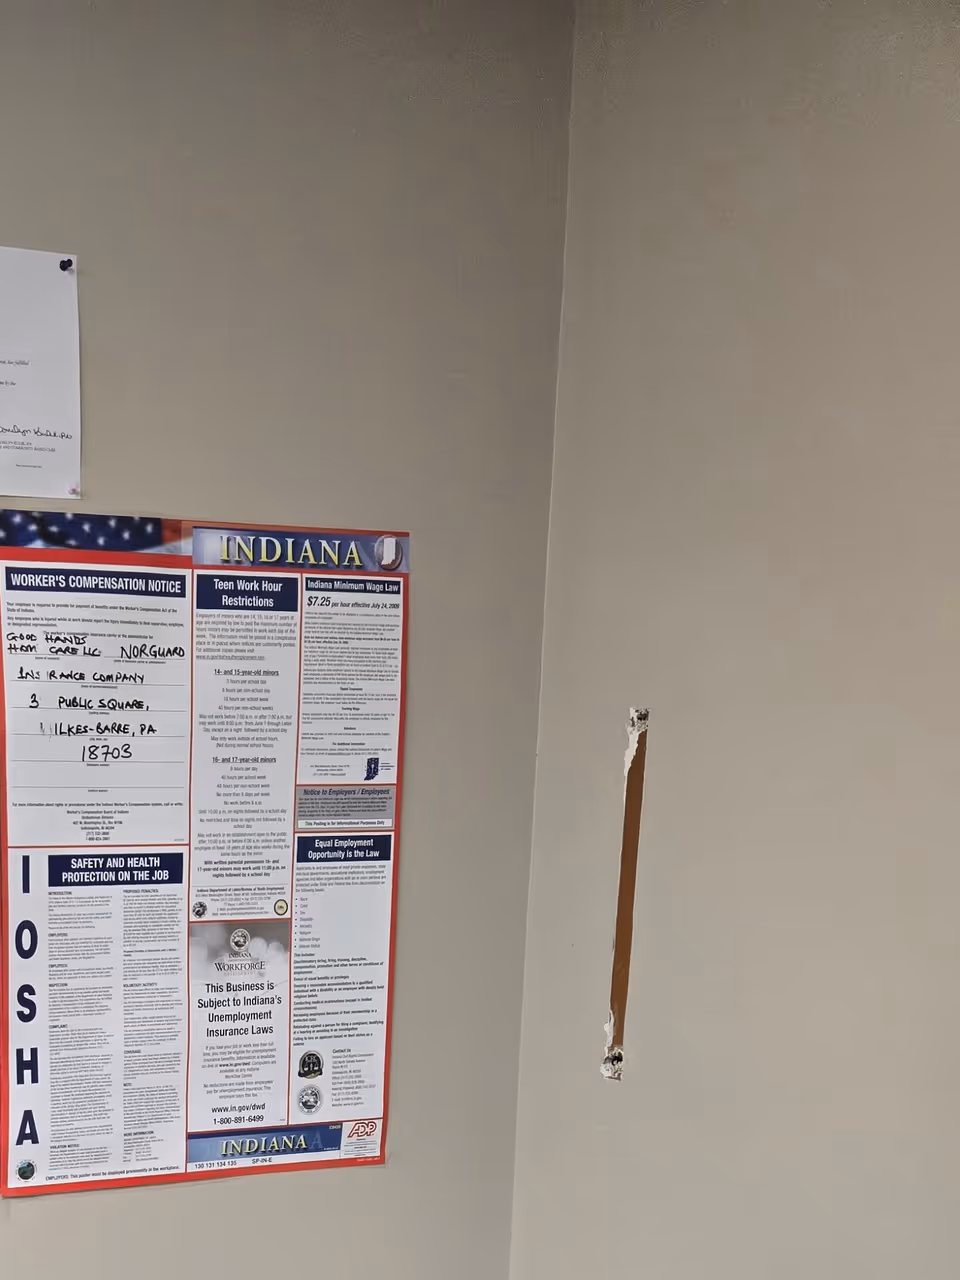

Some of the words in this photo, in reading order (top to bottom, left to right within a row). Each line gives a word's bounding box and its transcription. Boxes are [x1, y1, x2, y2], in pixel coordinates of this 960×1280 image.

[219, 535, 363, 568] INDIANA
[10, 573, 66, 587] WORKER'S
[68, 576, 146, 591] COMPENSATION
[148, 579, 181, 593] NOTICE
[213, 578, 234, 590] Teen
[236, 580, 260, 591] Work
[262, 580, 283, 592] Hour
[308, 580, 332, 589] Indiana
[334, 580, 365, 590] Minimum
[366, 582, 384, 592] Wage
[385, 583, 399, 592] Law
[222, 595, 274, 607] Restrictions
[307, 596, 331, 608] $7.25
[330, 600, 339, 608] per
[6, 632, 37, 642] GOOD
[44, 634, 87, 645] HANDS
[49, 646, 79, 654] CARE
[120, 644, 185, 659] NORGUARD
[92, 672, 145, 684] COMPANY
[58, 696, 94, 710] PUBLIC
[98, 699, 149, 711] SQUARE,
[140, 724, 157, 735] PA
[82, 744, 132, 762] 18703
[315, 839, 333, 849] Equal
[334, 839, 373, 848] Employment
[308, 850, 345, 860] Opportunity
[346, 850, 353, 858] is
[354, 850, 365, 858] the
[366, 849, 380, 857] Law
[71, 858, 104, 869] SAFETY
[106, 857, 124, 868] AND
[127, 857, 160, 868] HEALTH
[62, 871, 116, 882] PROTECTION
[118, 871, 130, 881] ON
[132, 870, 150, 881] THE
[152, 870, 169, 880] JOB
[214, 961, 266, 972] WORKFORCE
[205, 983, 224, 993] This
[226, 982, 265, 992] Business
[267, 980, 275, 990] is
[197, 997, 230, 1010] Subject
[232, 997, 241, 1007] to
[243, 995, 282, 1006] Indiana's
[208, 1010, 272, 1023] Unemployment
[206, 1027, 249, 1037] Insurance
[251, 1025, 273, 1035] Laws
[211, 1103, 266, 1113] www.in.gov/dwd
[213, 1114, 264, 1125] 1-800-891-6499
[347, 1121, 378, 1138] ADP
[221, 1134, 308, 1156] INDIANA
